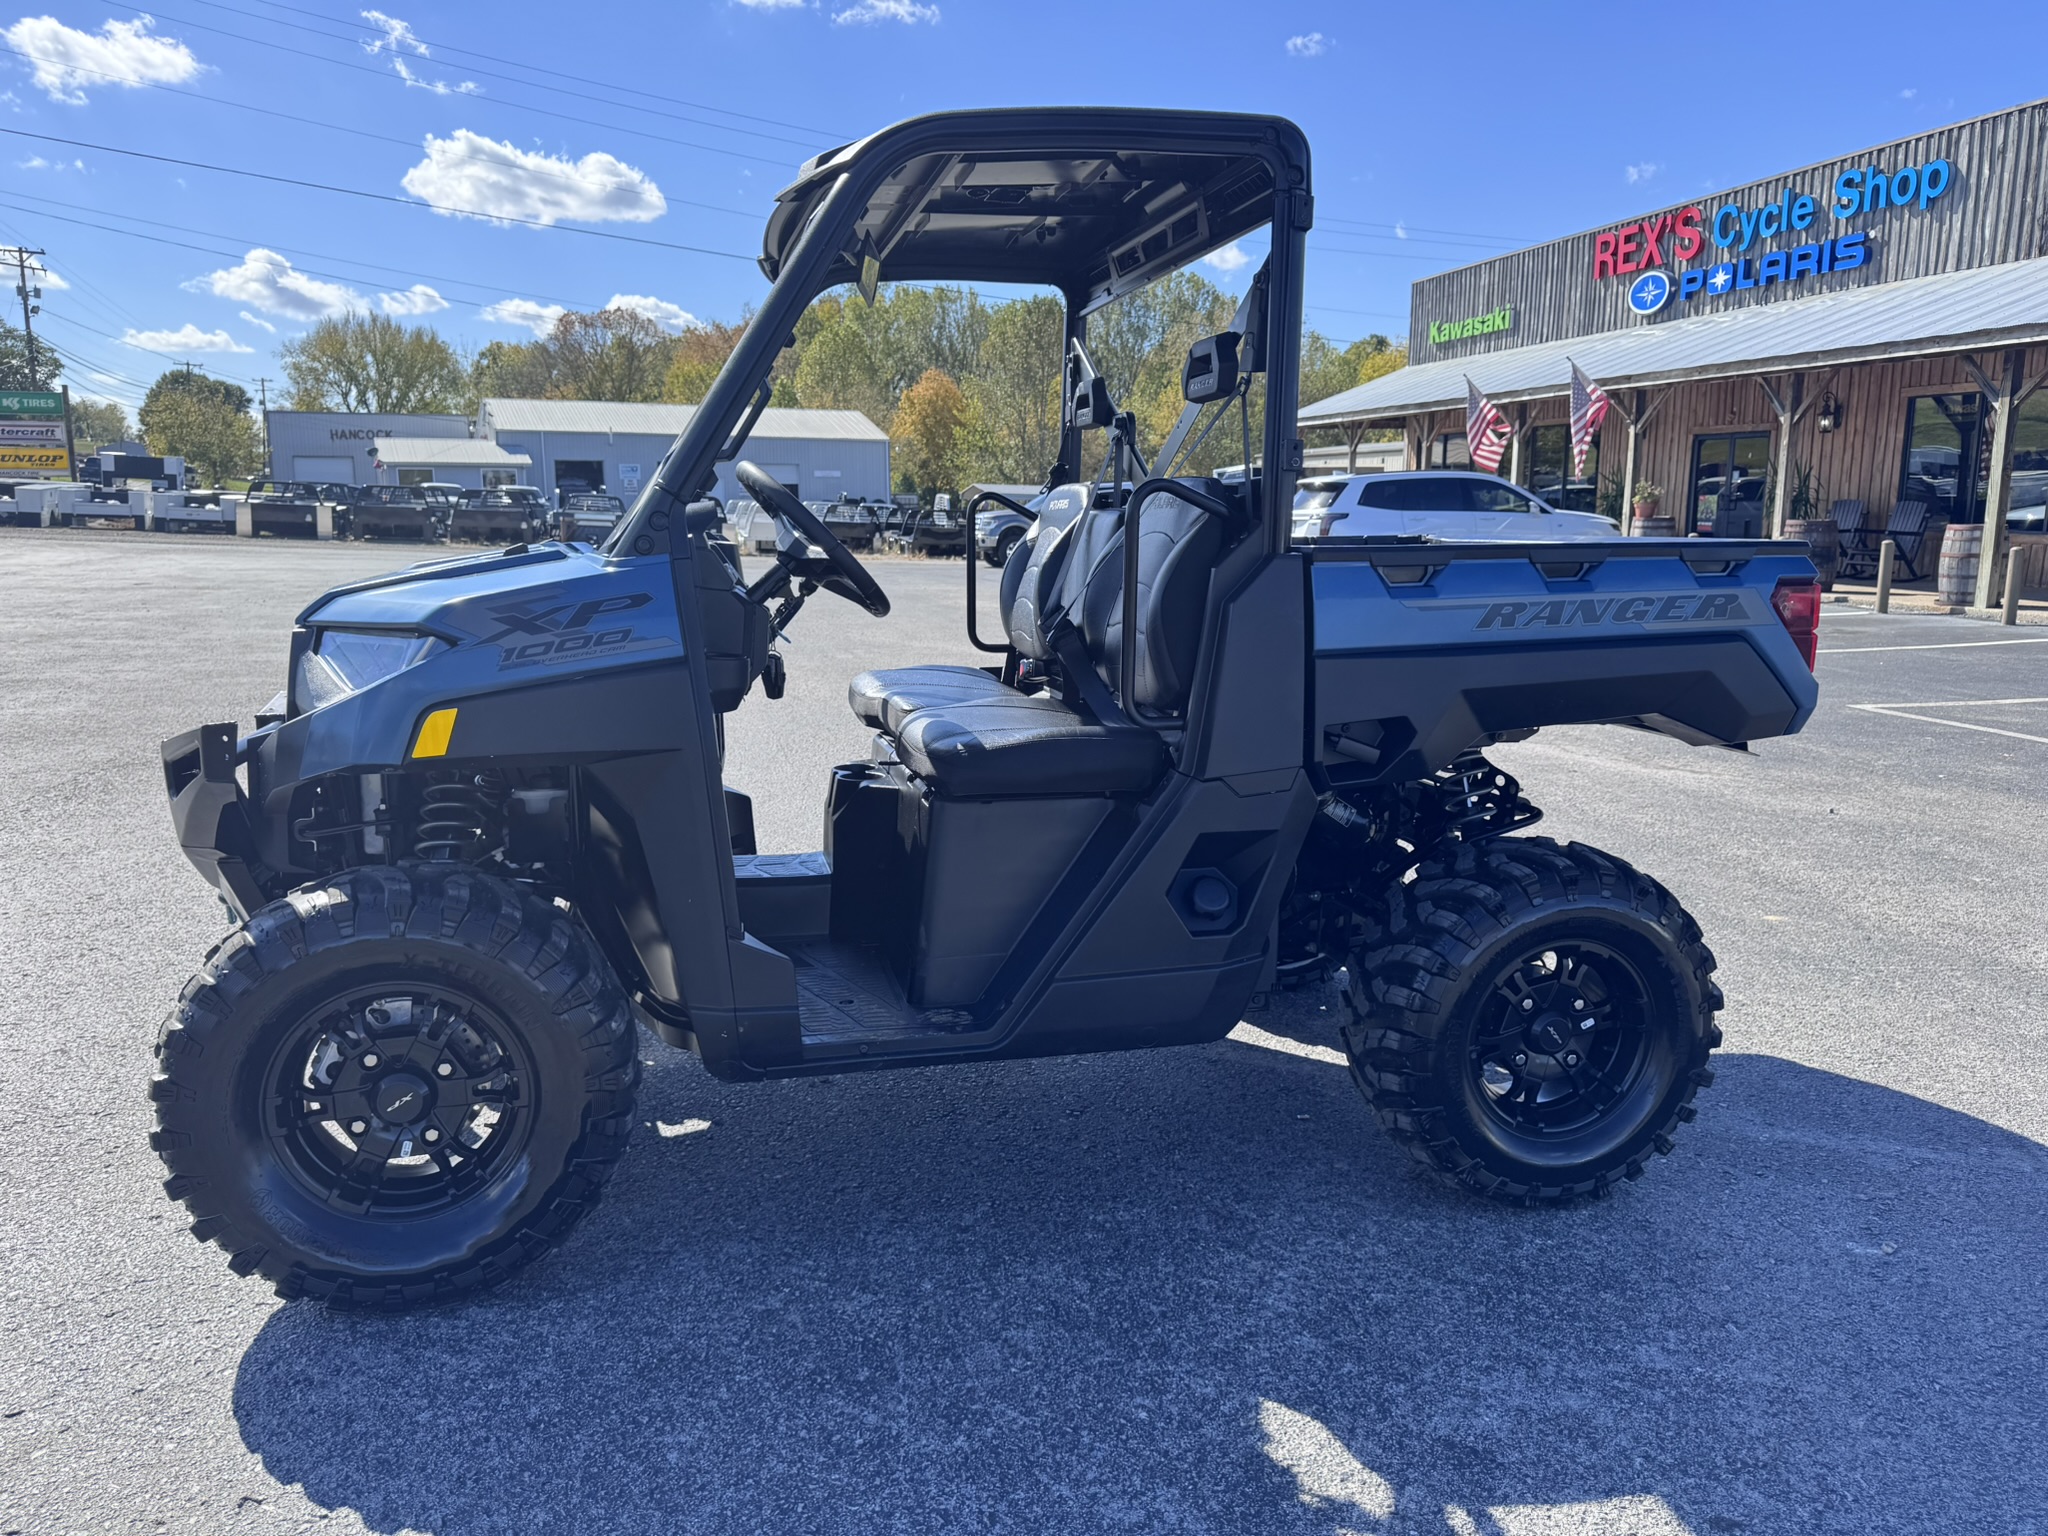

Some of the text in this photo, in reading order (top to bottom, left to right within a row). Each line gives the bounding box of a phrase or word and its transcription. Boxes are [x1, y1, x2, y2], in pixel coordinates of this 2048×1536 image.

[1594, 158, 1953, 280] REX'S Cycle Shop
[1680, 231, 1871, 301] POLARIS
[1429, 303, 1511, 344] Kawasaki
[22, 398, 56, 408] TIRES
[330, 429, 393, 441] HANCOCK
[470, 592, 656, 648] XP
[1472, 593, 1741, 631] RANGER
[500, 627, 634, 664] 1000
[386, 1091, 414, 1112] XP
